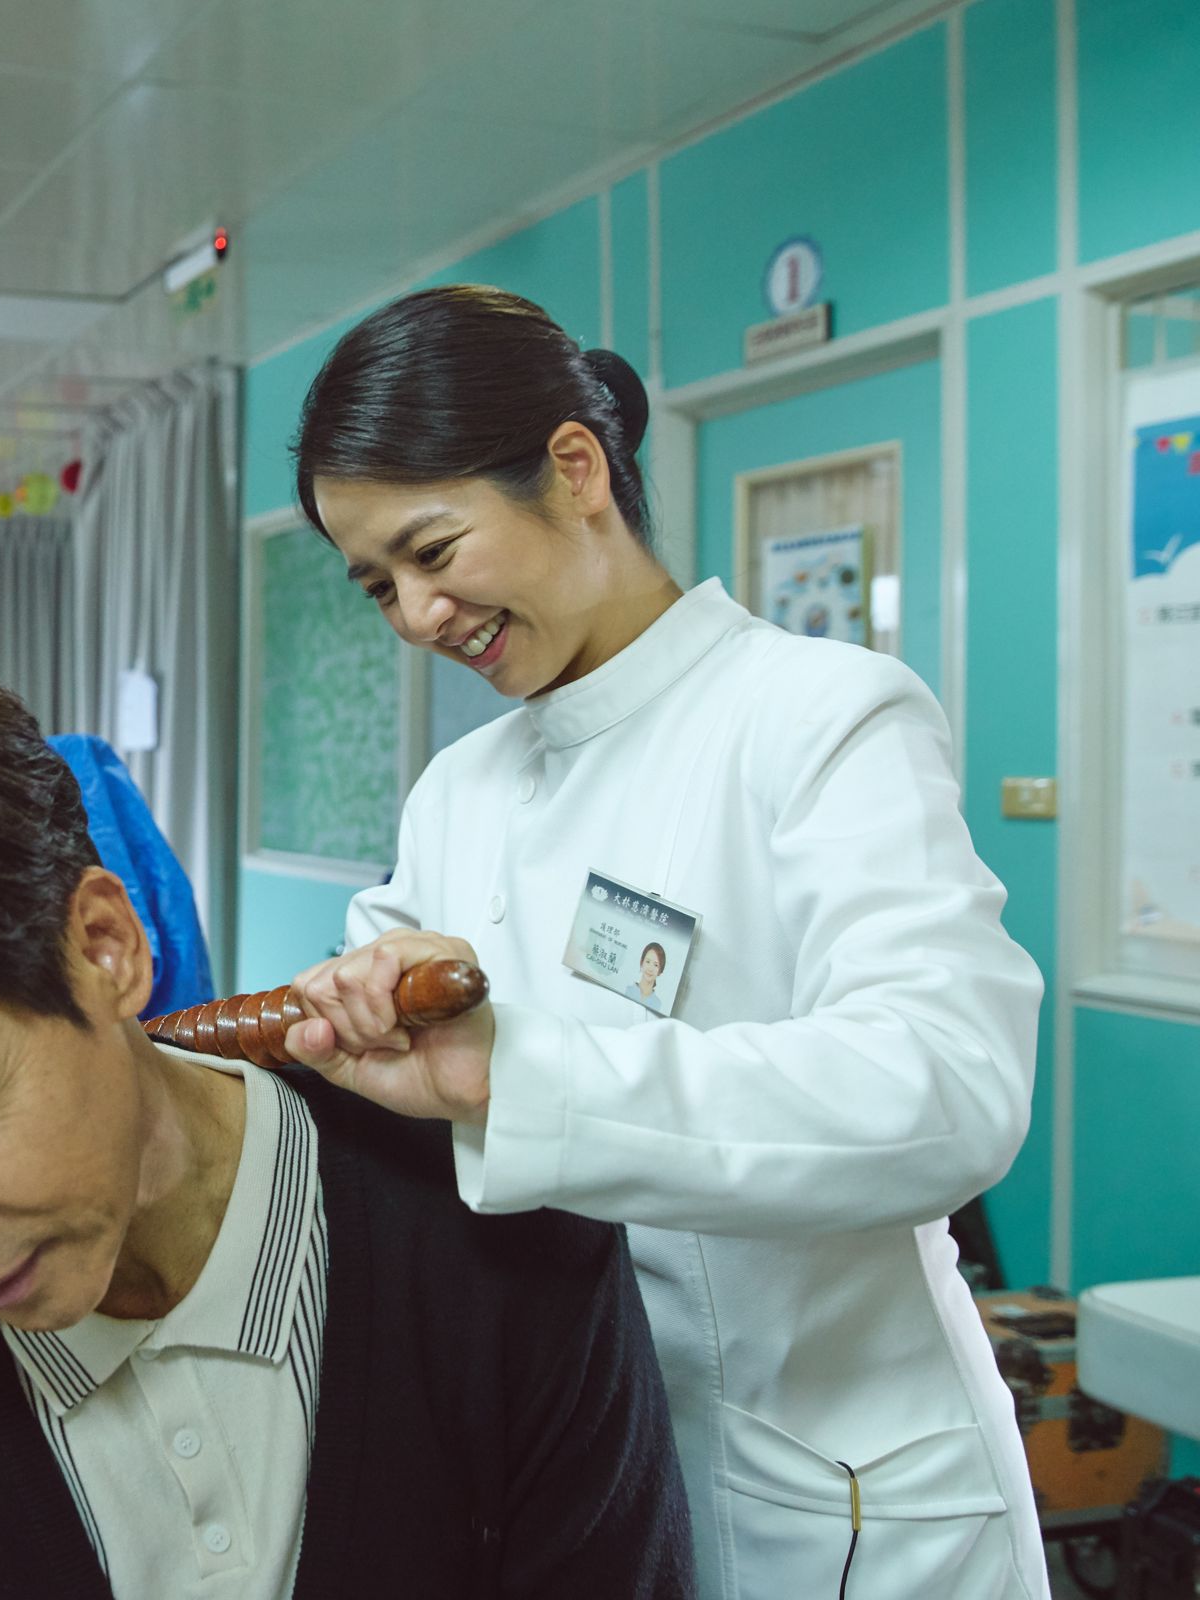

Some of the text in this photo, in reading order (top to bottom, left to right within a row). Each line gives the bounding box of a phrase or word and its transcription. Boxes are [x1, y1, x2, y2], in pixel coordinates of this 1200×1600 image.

[613, 892, 669, 926] 大林慈濟醫院
